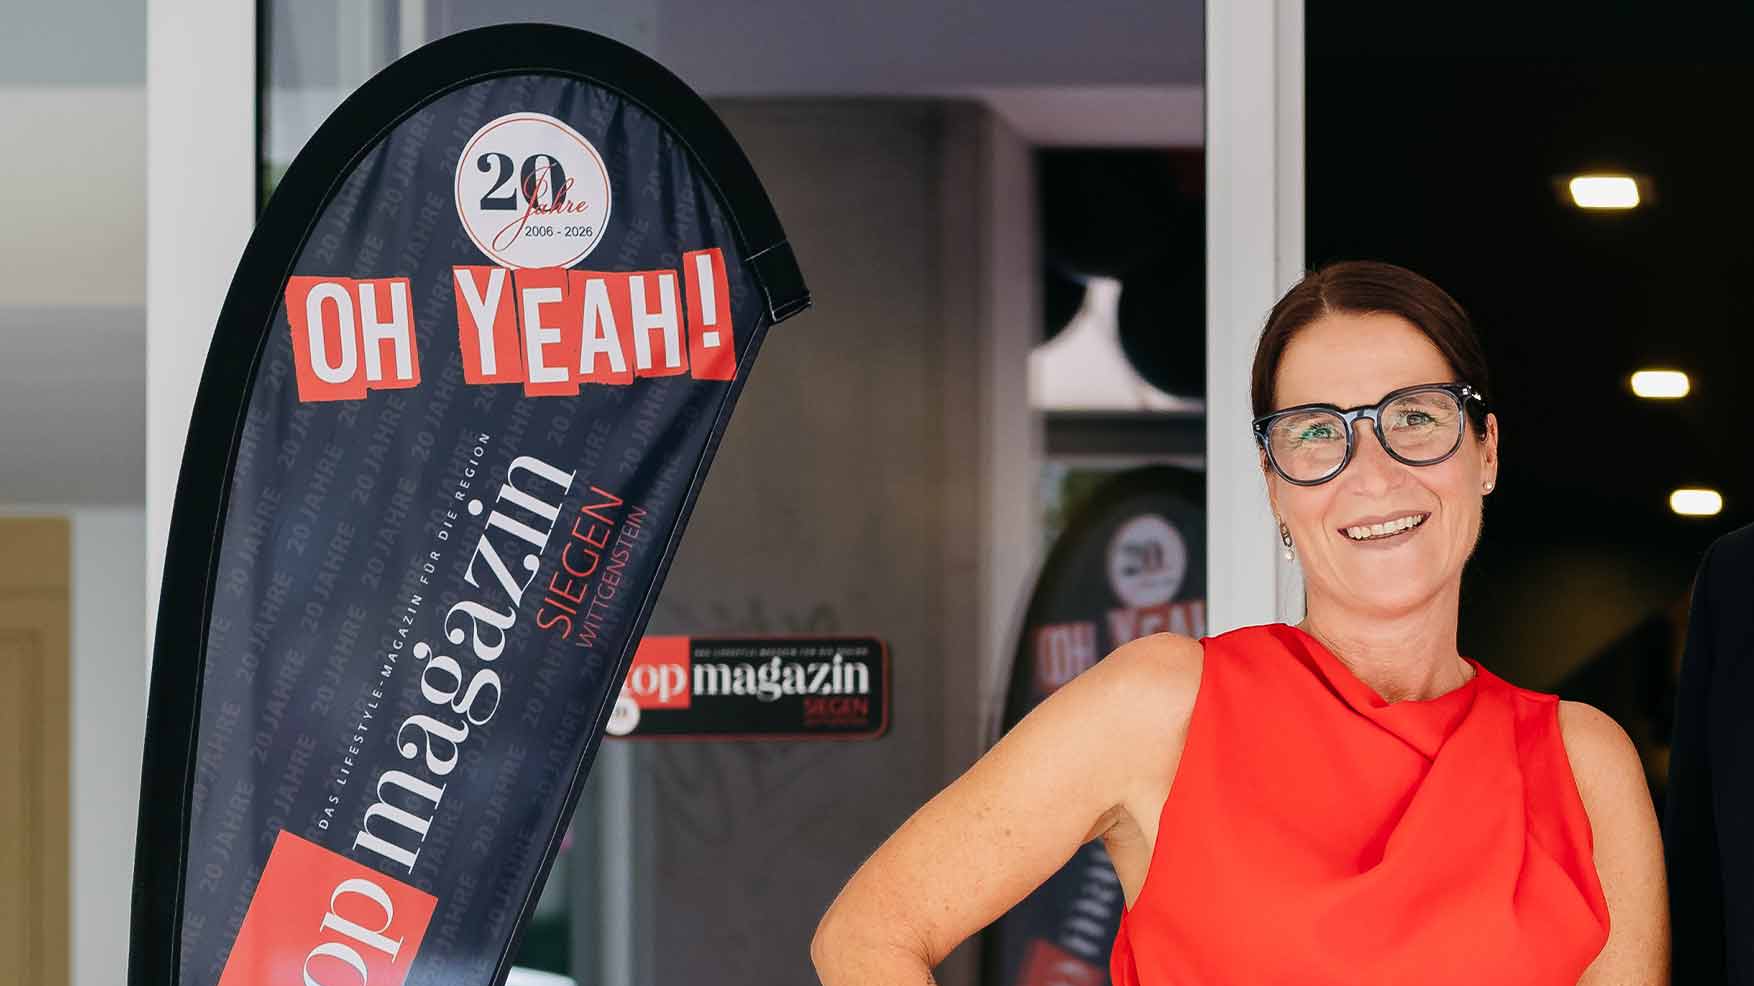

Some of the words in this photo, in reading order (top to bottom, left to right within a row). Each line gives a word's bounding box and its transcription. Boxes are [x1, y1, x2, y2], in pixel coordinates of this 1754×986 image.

[477, 152, 567, 212] 20
[492, 165, 590, 252] Jahre
[525, 225, 554, 239] 2006
[565, 225, 593, 239] 2026
[305, 281, 413, 384] OH
[453, 253, 720, 383] YEAH!
[535, 485, 624, 640] SIEGEN
[575, 505, 649, 649] WITTGENSTEIN
[318, 794, 340, 830] DAS
[336, 593, 424, 786] LIFESTYLE-MAGAZIN
[437, 510, 458, 542] DIE
[454, 432, 491, 501] REGION
[352, 455, 577, 874] magazin
[620, 662, 688, 704] op
[693, 653, 869, 702] magazin
